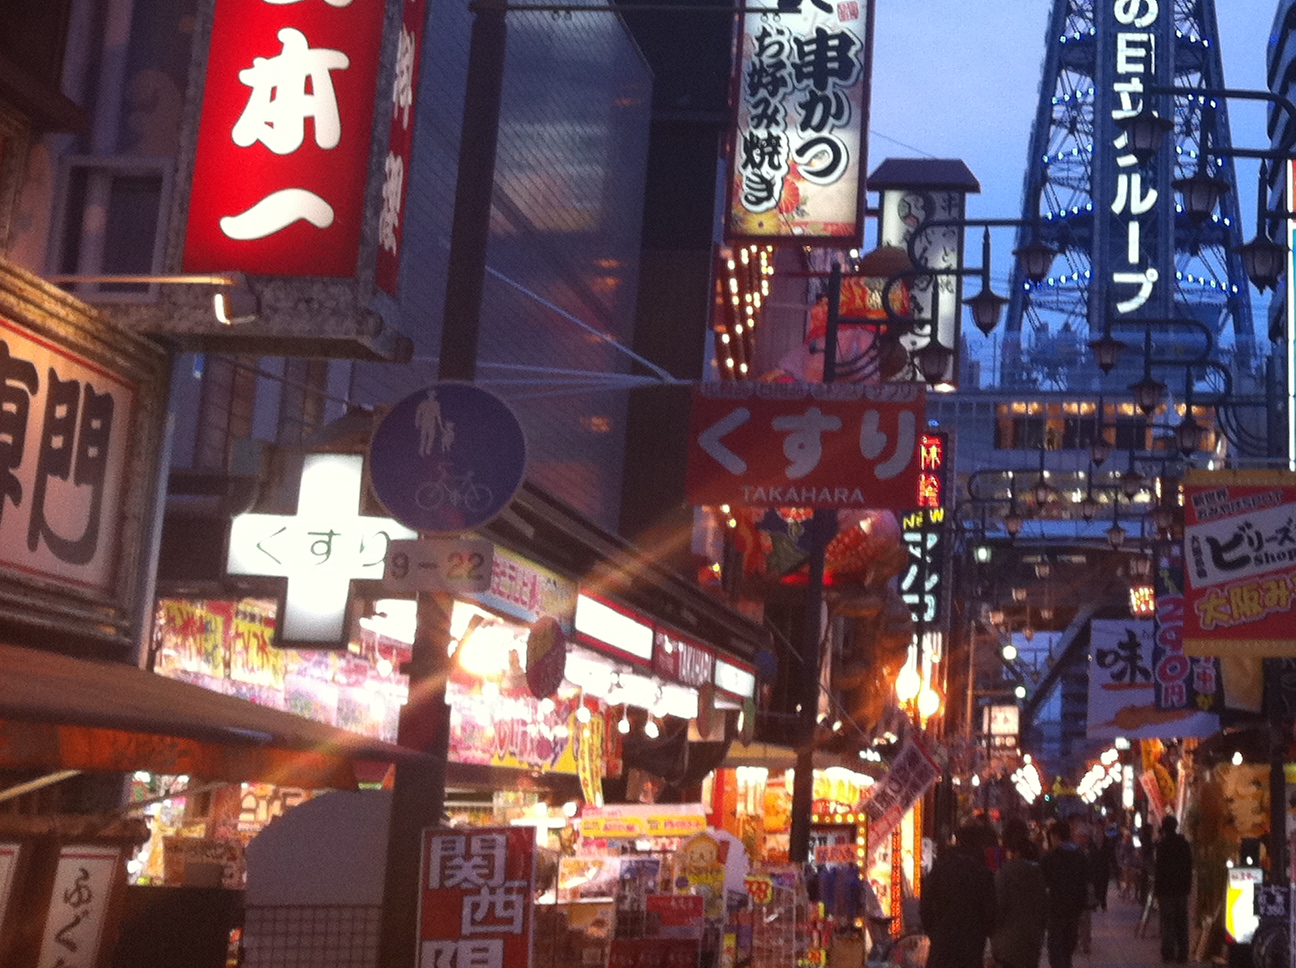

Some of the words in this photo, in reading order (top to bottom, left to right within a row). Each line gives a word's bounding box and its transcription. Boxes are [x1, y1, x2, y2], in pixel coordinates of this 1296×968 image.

[740, 23, 792, 211] お好み焼き
[795, 28, 861, 184] 串かつ
[699, 407, 919, 478] くすり
[740, 484, 865, 505] TAKAHARA
[256, 526, 391, 566] くすり
[1205, 517, 1296, 571] ビリーズ
